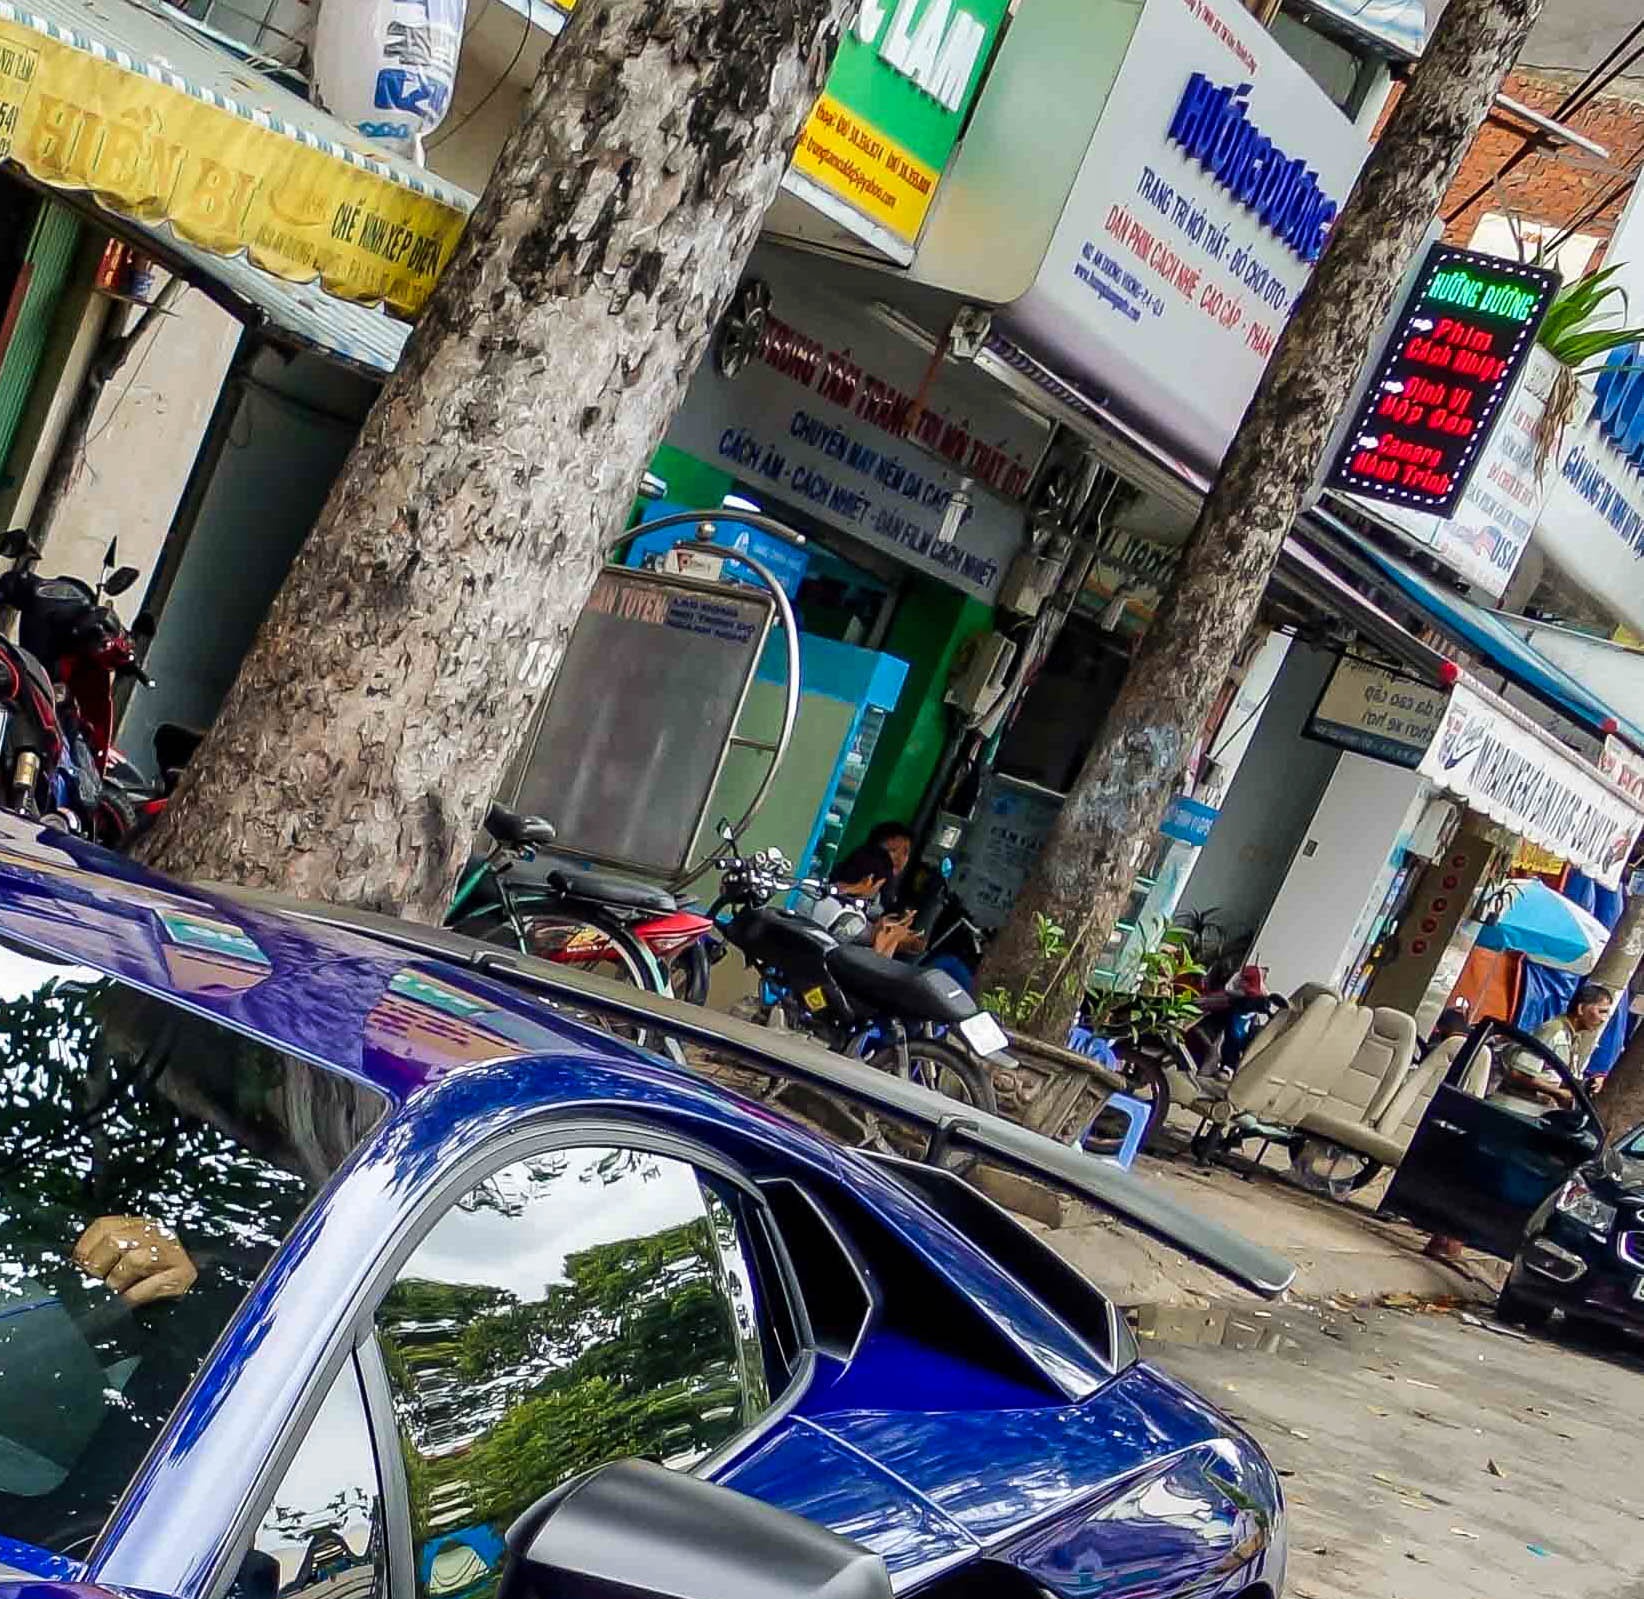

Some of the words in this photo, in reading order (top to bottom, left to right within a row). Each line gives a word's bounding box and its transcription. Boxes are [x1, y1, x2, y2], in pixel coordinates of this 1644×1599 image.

[1137, 166, 1174, 214] TRANG
[1479, 284, 1535, 321] DƯƠNG
[1433, 318, 1494, 350] Phim
[1490, 532, 1519, 574] USA
